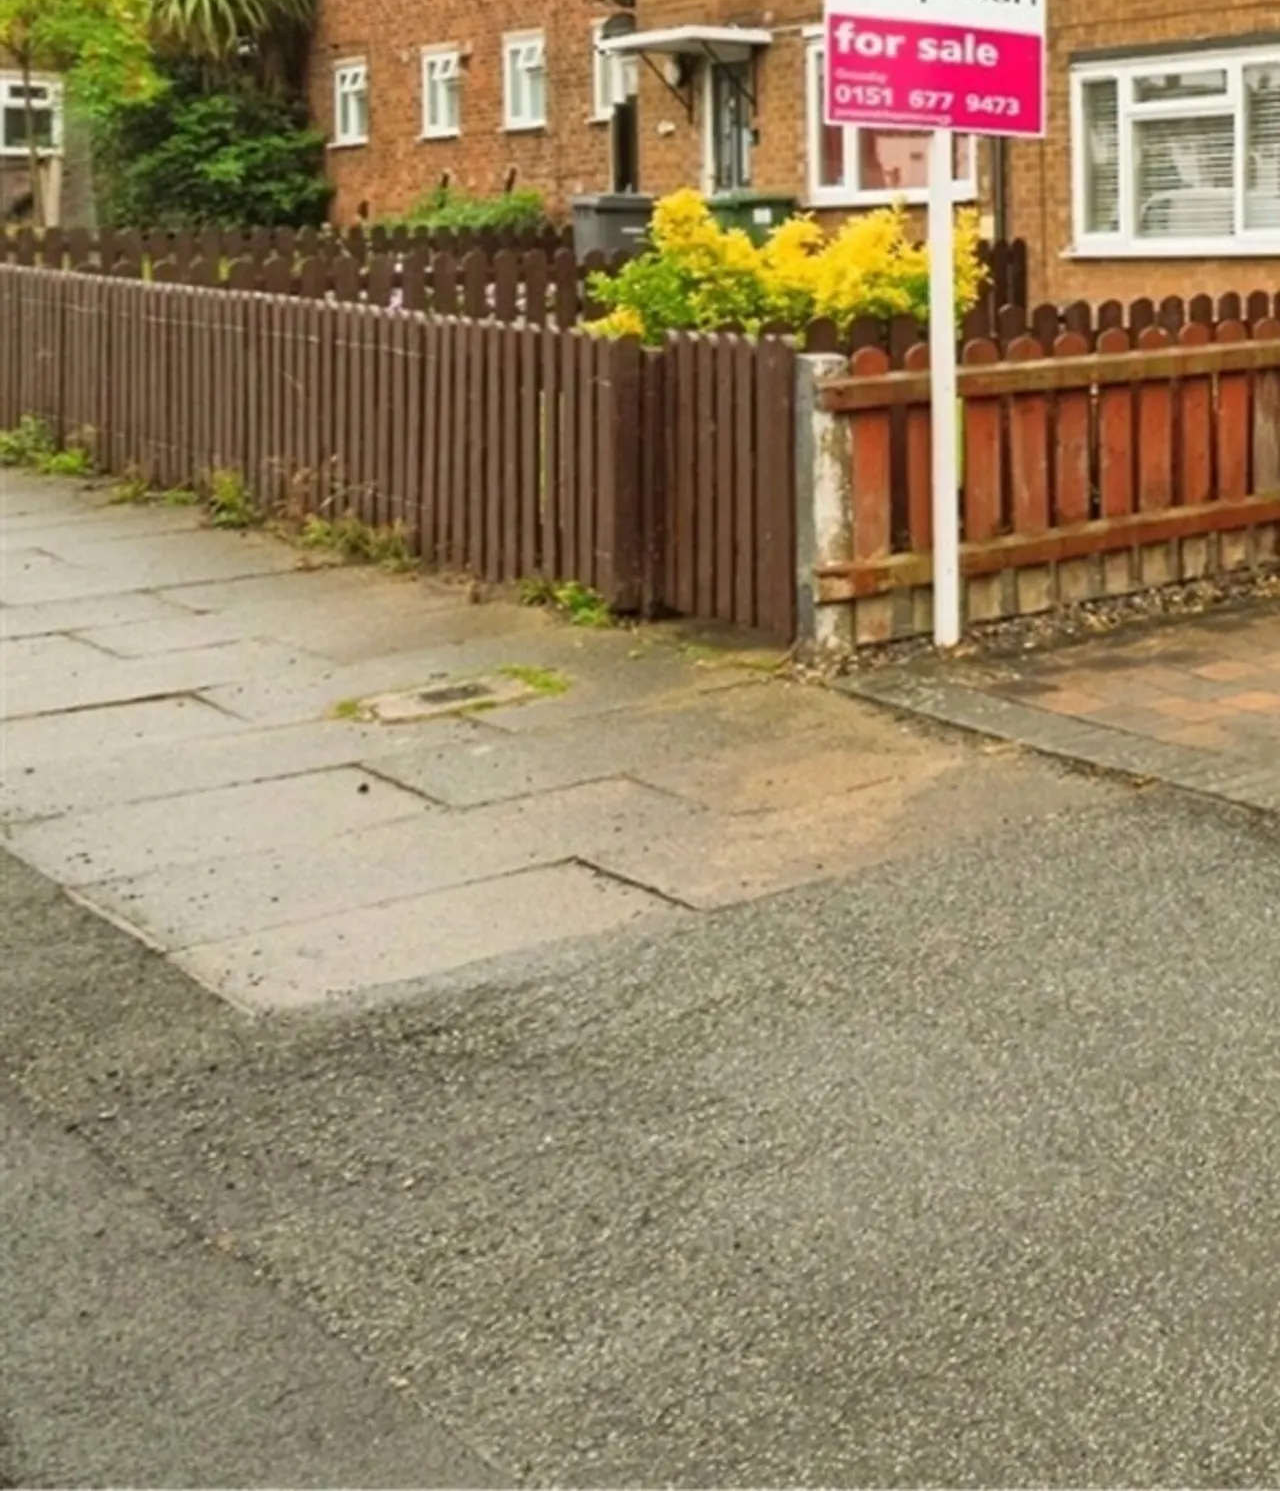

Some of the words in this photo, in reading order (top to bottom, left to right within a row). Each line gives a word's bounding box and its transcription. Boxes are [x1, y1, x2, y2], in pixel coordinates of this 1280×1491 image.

[834, 21, 905, 58] for
[917, 33, 999, 67] sale
[835, 83, 893, 106] 0151
[908, 89, 955, 110] 677
[965, 92, 1020, 116] 9473
